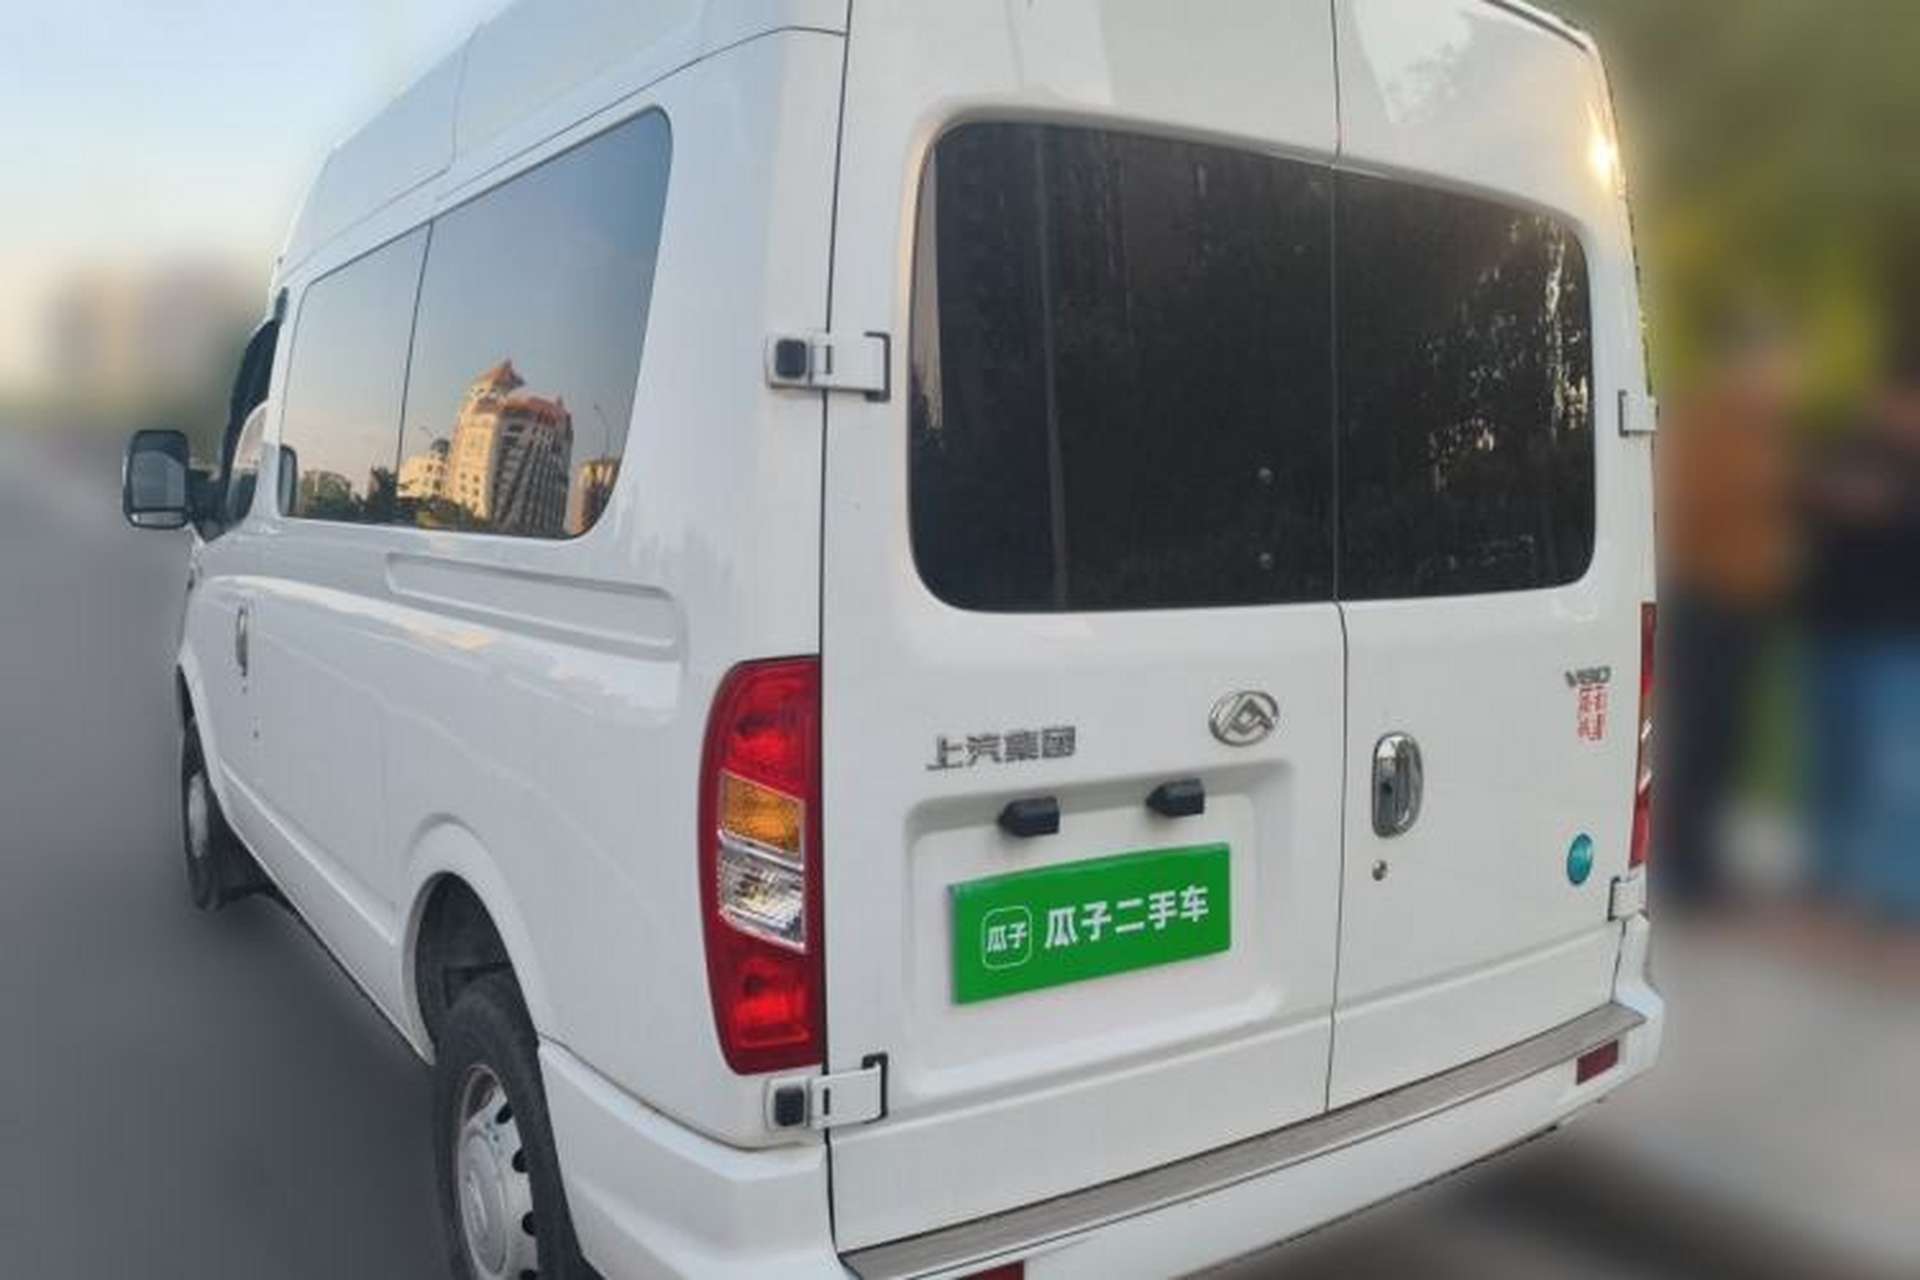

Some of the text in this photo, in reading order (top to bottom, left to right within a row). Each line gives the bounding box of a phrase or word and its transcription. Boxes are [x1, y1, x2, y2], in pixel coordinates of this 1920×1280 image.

[926, 726, 1076, 771] 上汽集团
[986, 921, 1028, 953] 瓜子
[1044, 885, 1209, 949] 瓜子二手车
